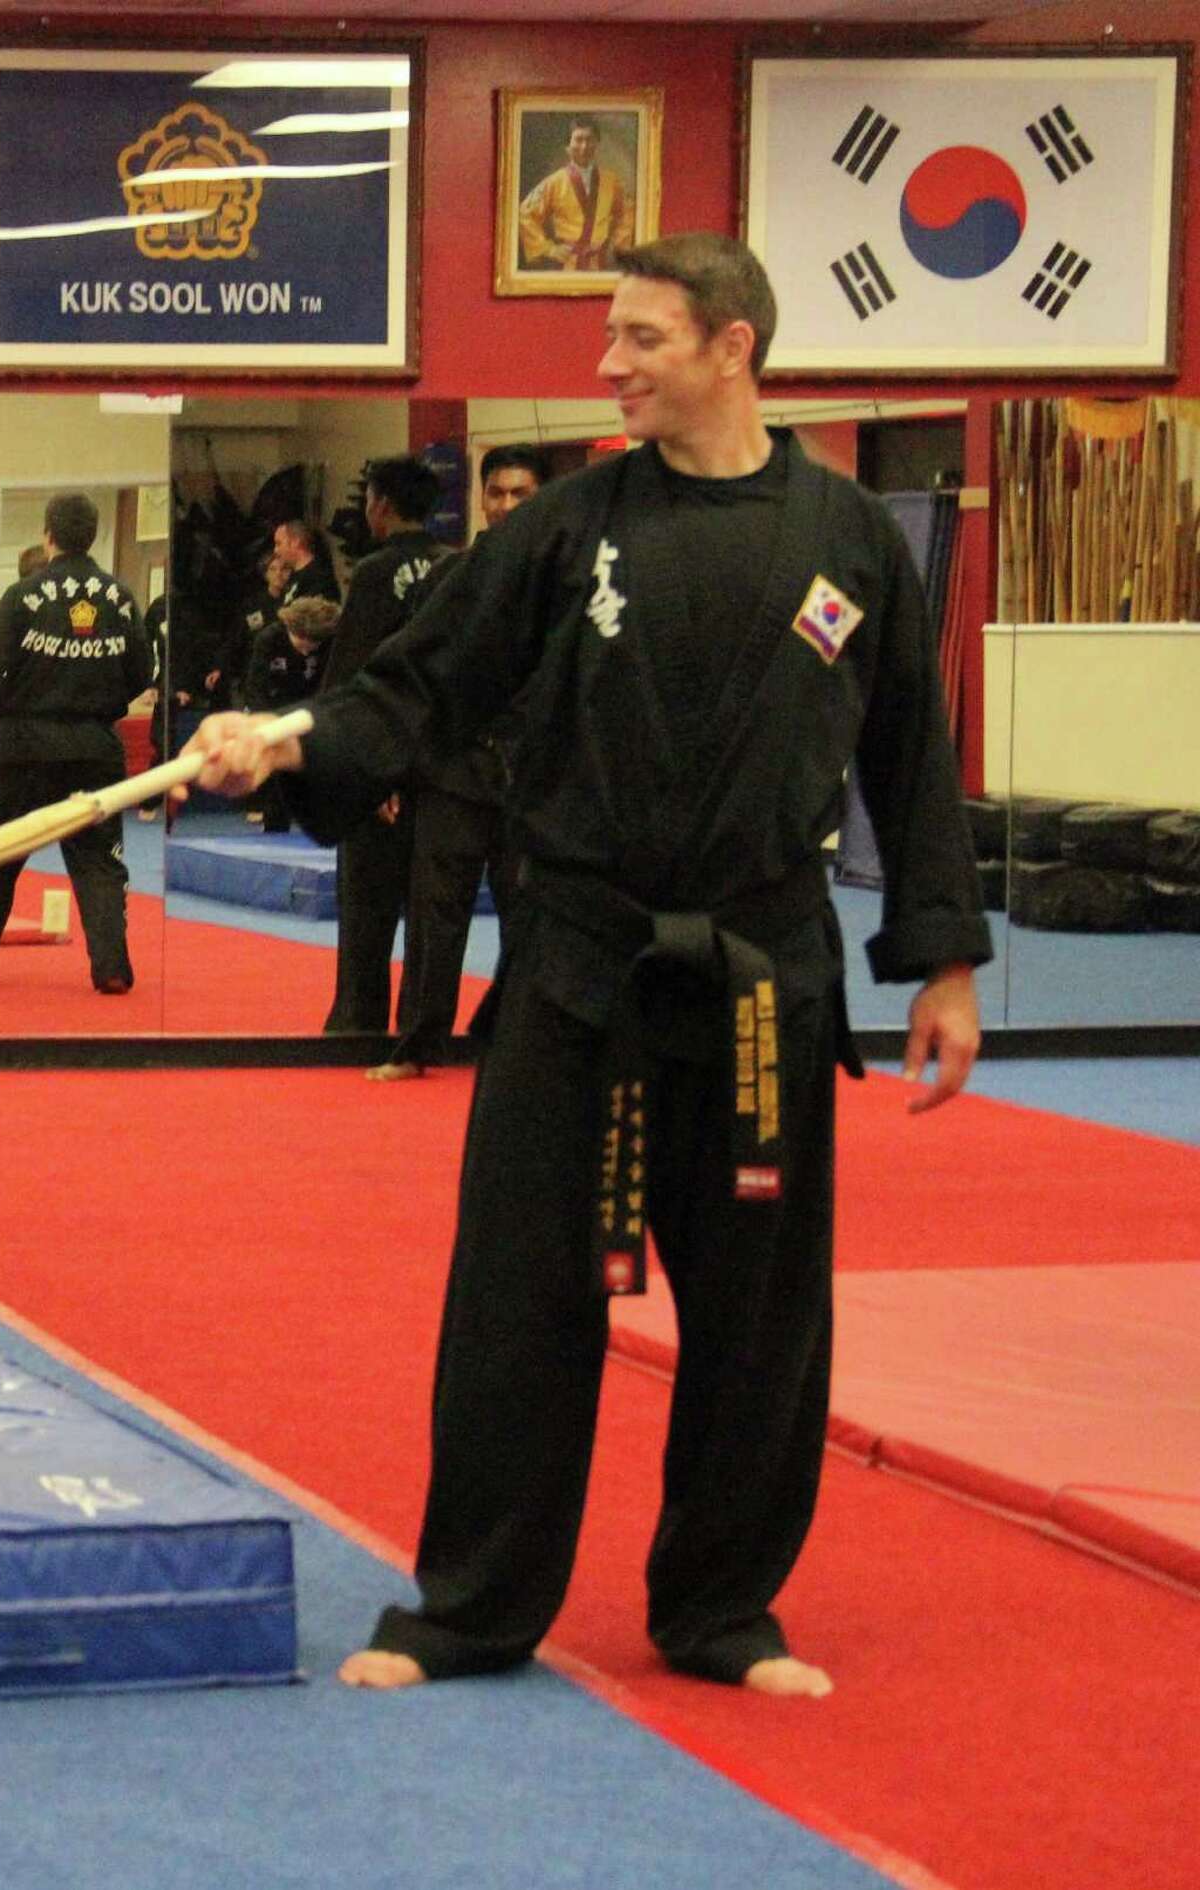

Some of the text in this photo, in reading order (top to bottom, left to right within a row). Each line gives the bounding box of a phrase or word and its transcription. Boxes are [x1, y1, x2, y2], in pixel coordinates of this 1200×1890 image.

[59, 281, 322, 315] KUK SOOL WON TM
